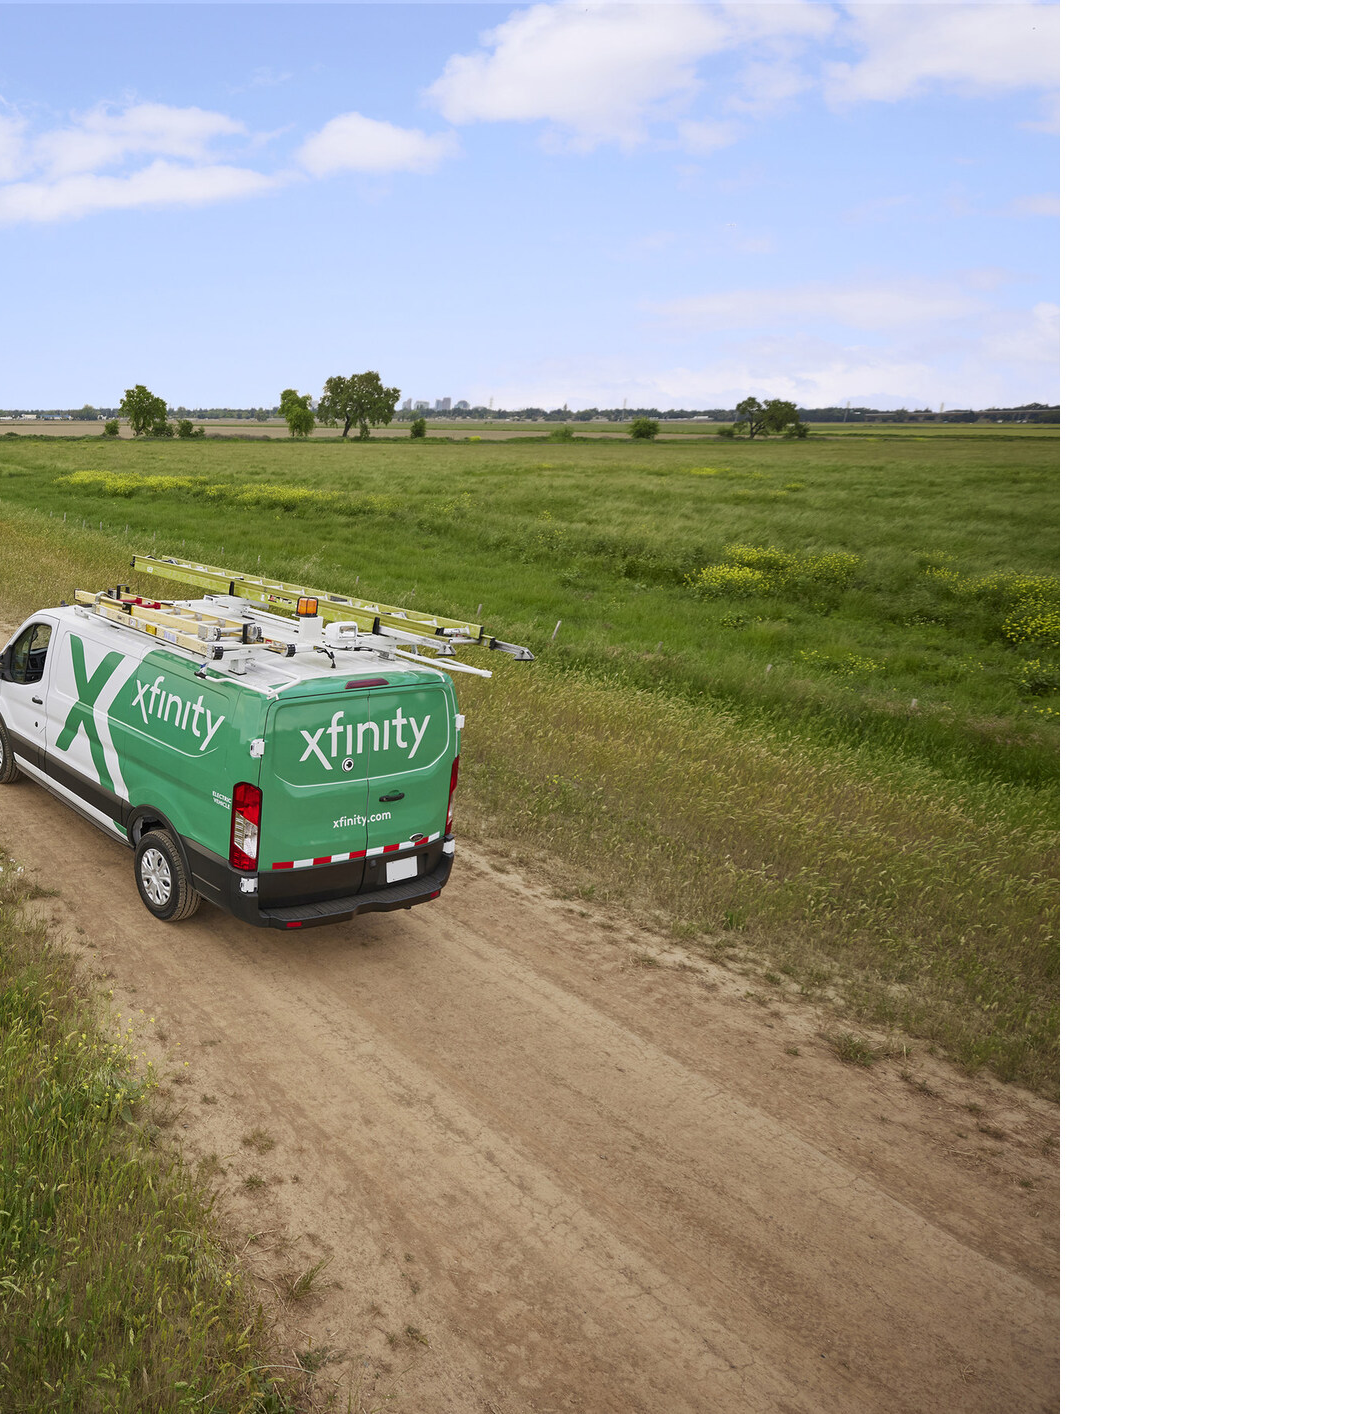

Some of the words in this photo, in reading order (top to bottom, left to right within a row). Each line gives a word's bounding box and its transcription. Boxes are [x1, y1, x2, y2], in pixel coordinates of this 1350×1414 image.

[131, 675, 226, 752] xfinity
[298, 706, 431, 771] xfinity
[332, 811, 392, 829] xfinity.com
